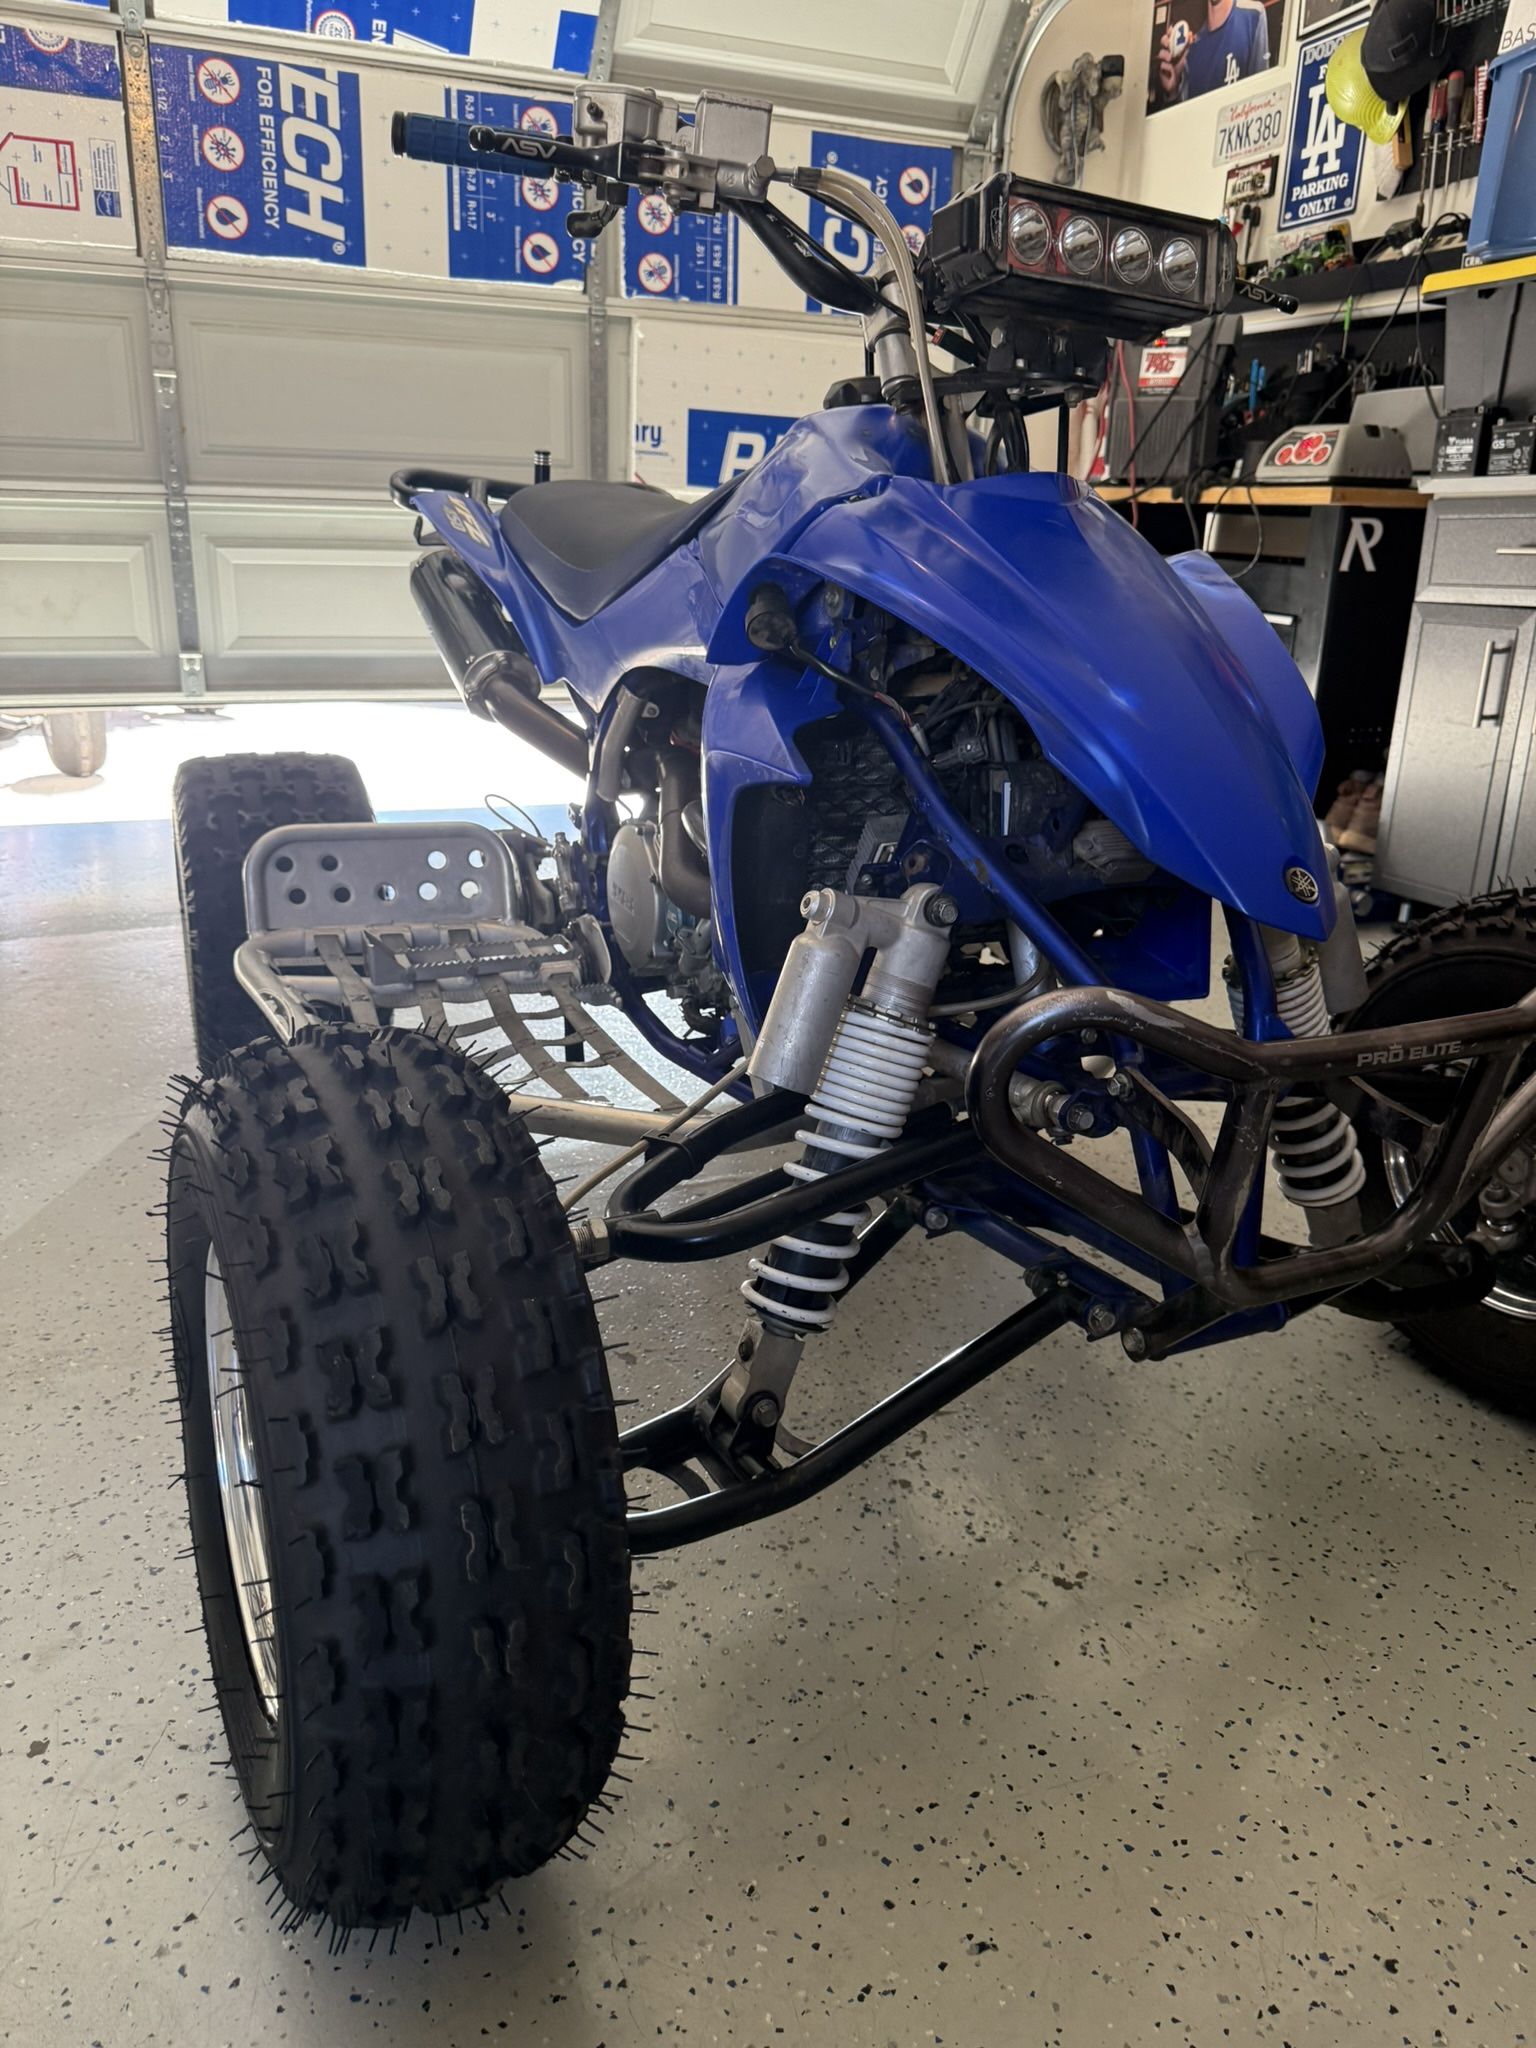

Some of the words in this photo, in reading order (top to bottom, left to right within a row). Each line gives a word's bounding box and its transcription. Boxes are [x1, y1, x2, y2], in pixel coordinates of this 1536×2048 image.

[256, 66, 273, 108] FOR
[1219, 110, 1282, 156] 7KNK380
[1301, 83, 1346, 181] LA
[259, 114, 280, 229] EFFICIENCY
[1292, 173, 1349, 202] PARKING
[1298, 196, 1337, 218] ONLY!
[1357, 1048, 1404, 1067] PRO
[1409, 1041, 1462, 1060] ELITE
